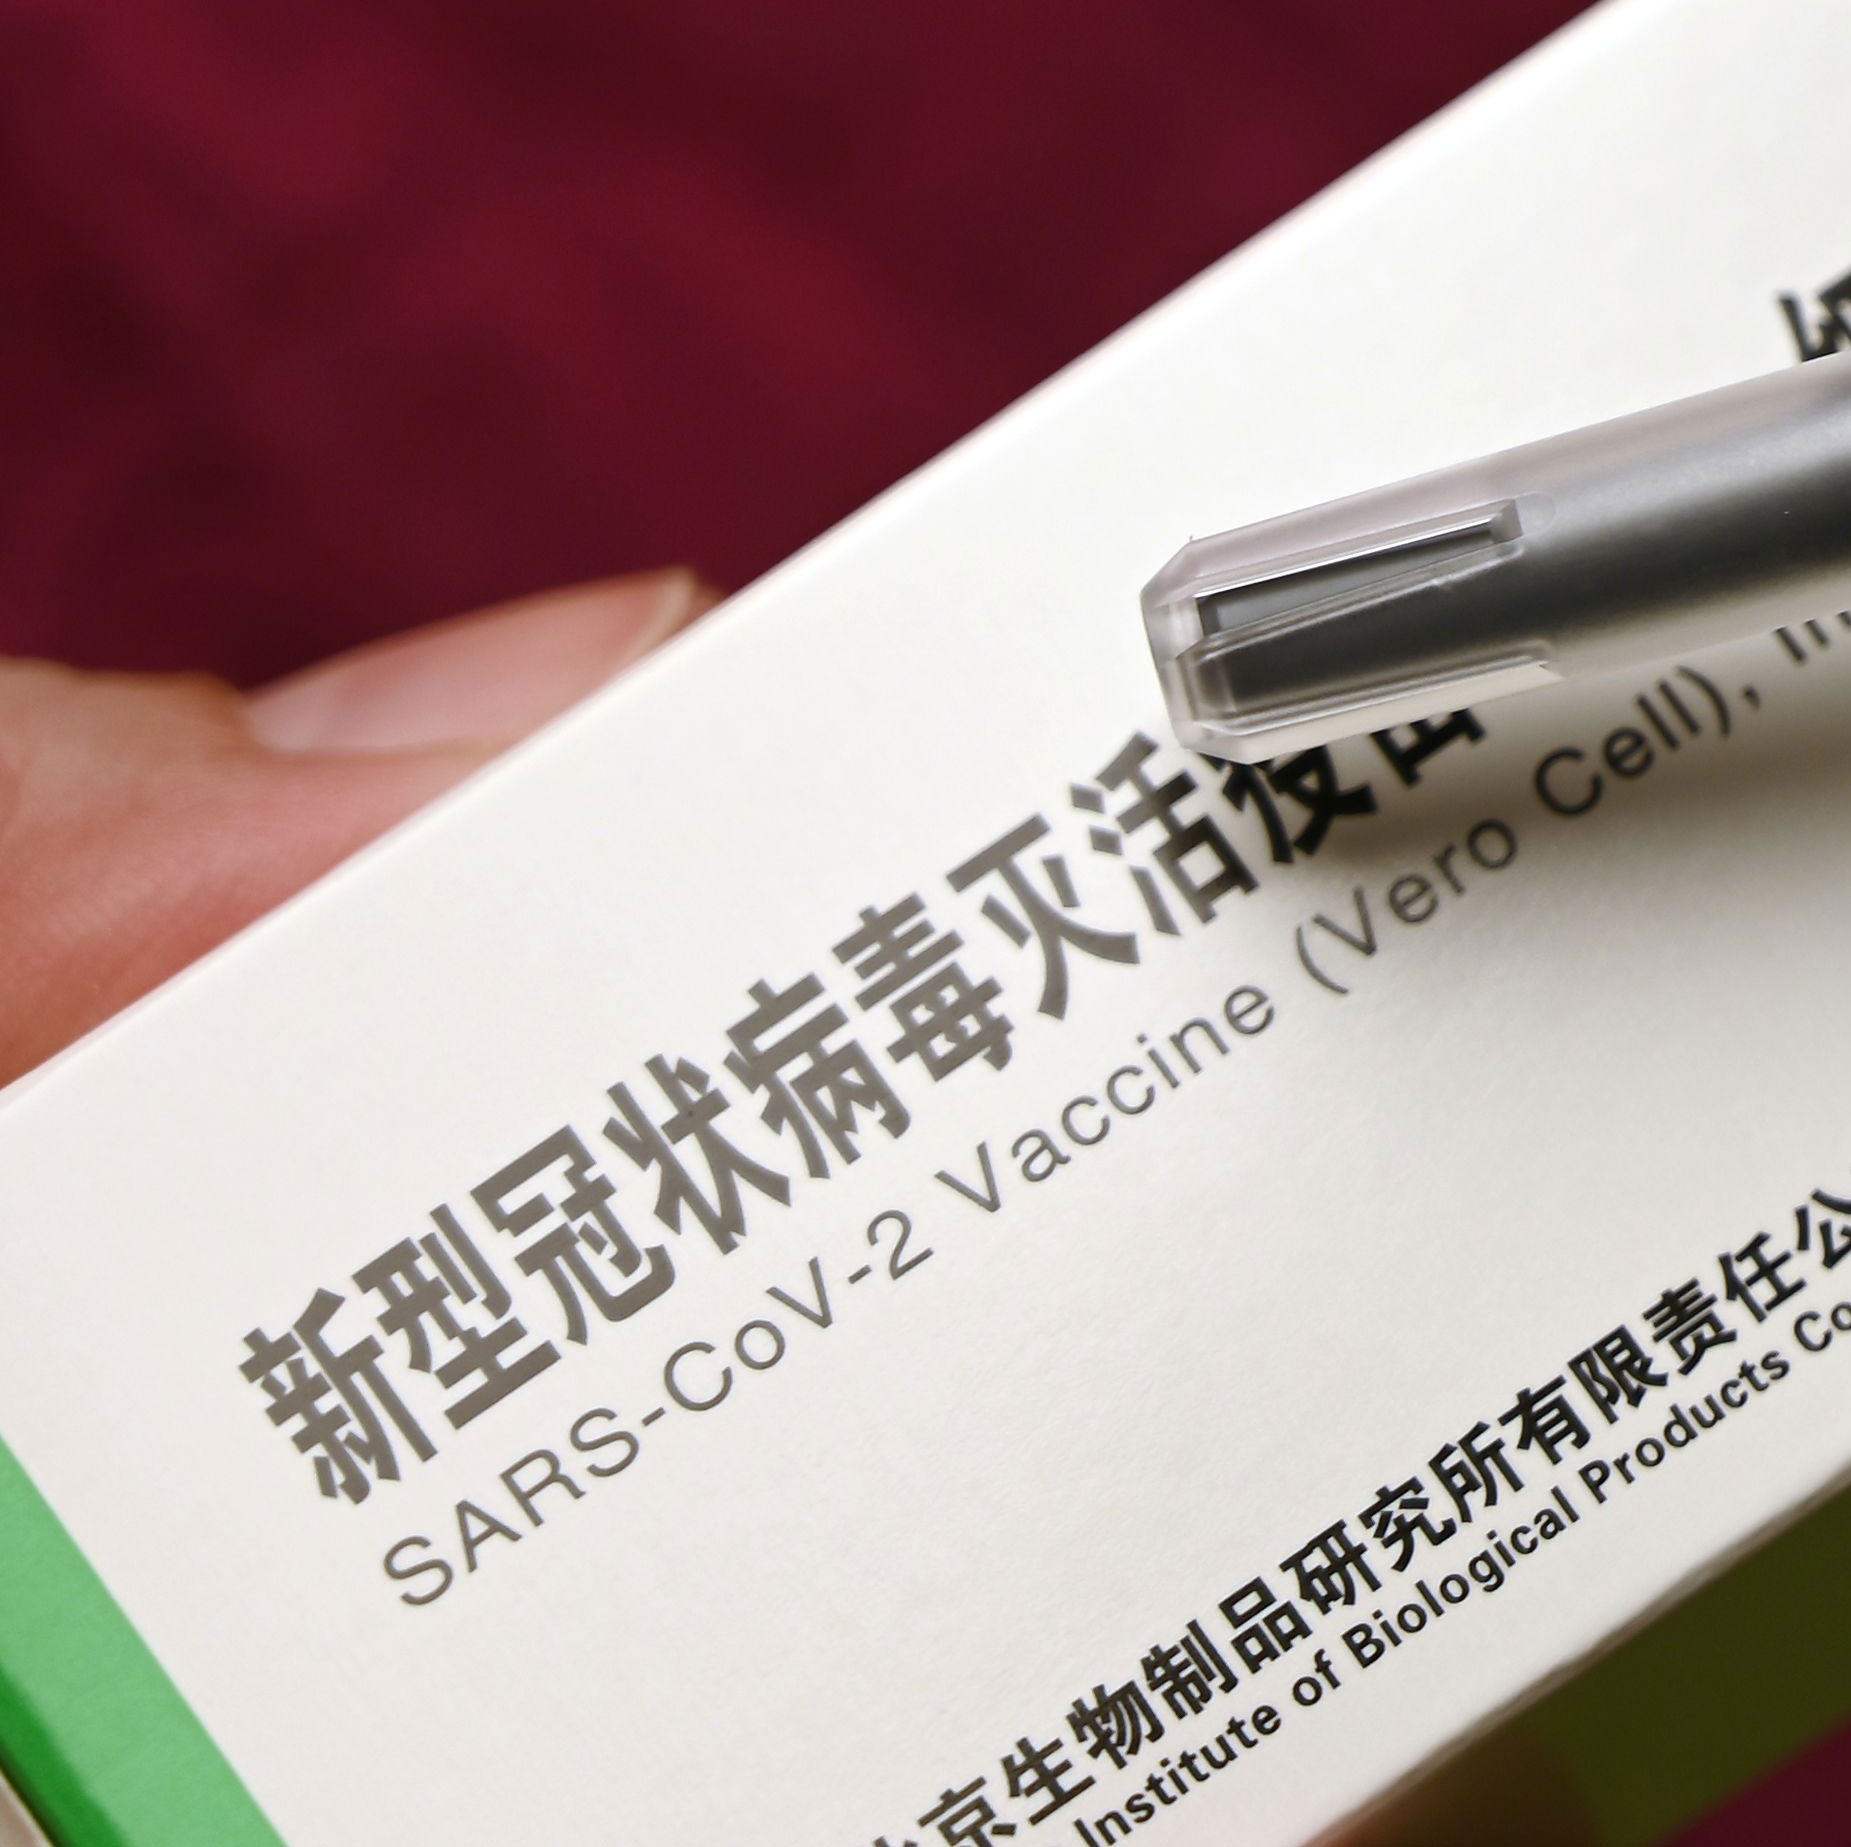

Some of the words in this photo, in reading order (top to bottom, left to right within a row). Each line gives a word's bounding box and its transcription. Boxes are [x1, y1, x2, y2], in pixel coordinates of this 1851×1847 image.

[383, 1208, 934, 1607] SARS-CoV-2
[934, 983, 1276, 1213] Vaccine
[1295, 819, 1518, 994] (Vero
[1533, 663, 1762, 819] Cell),
[1074, 1704, 1283, 1847] Institute
[1292, 1653, 1346, 1711] of
[1341, 1486, 1580, 1670] Biological
[1581, 1342, 1791, 1507] Products
